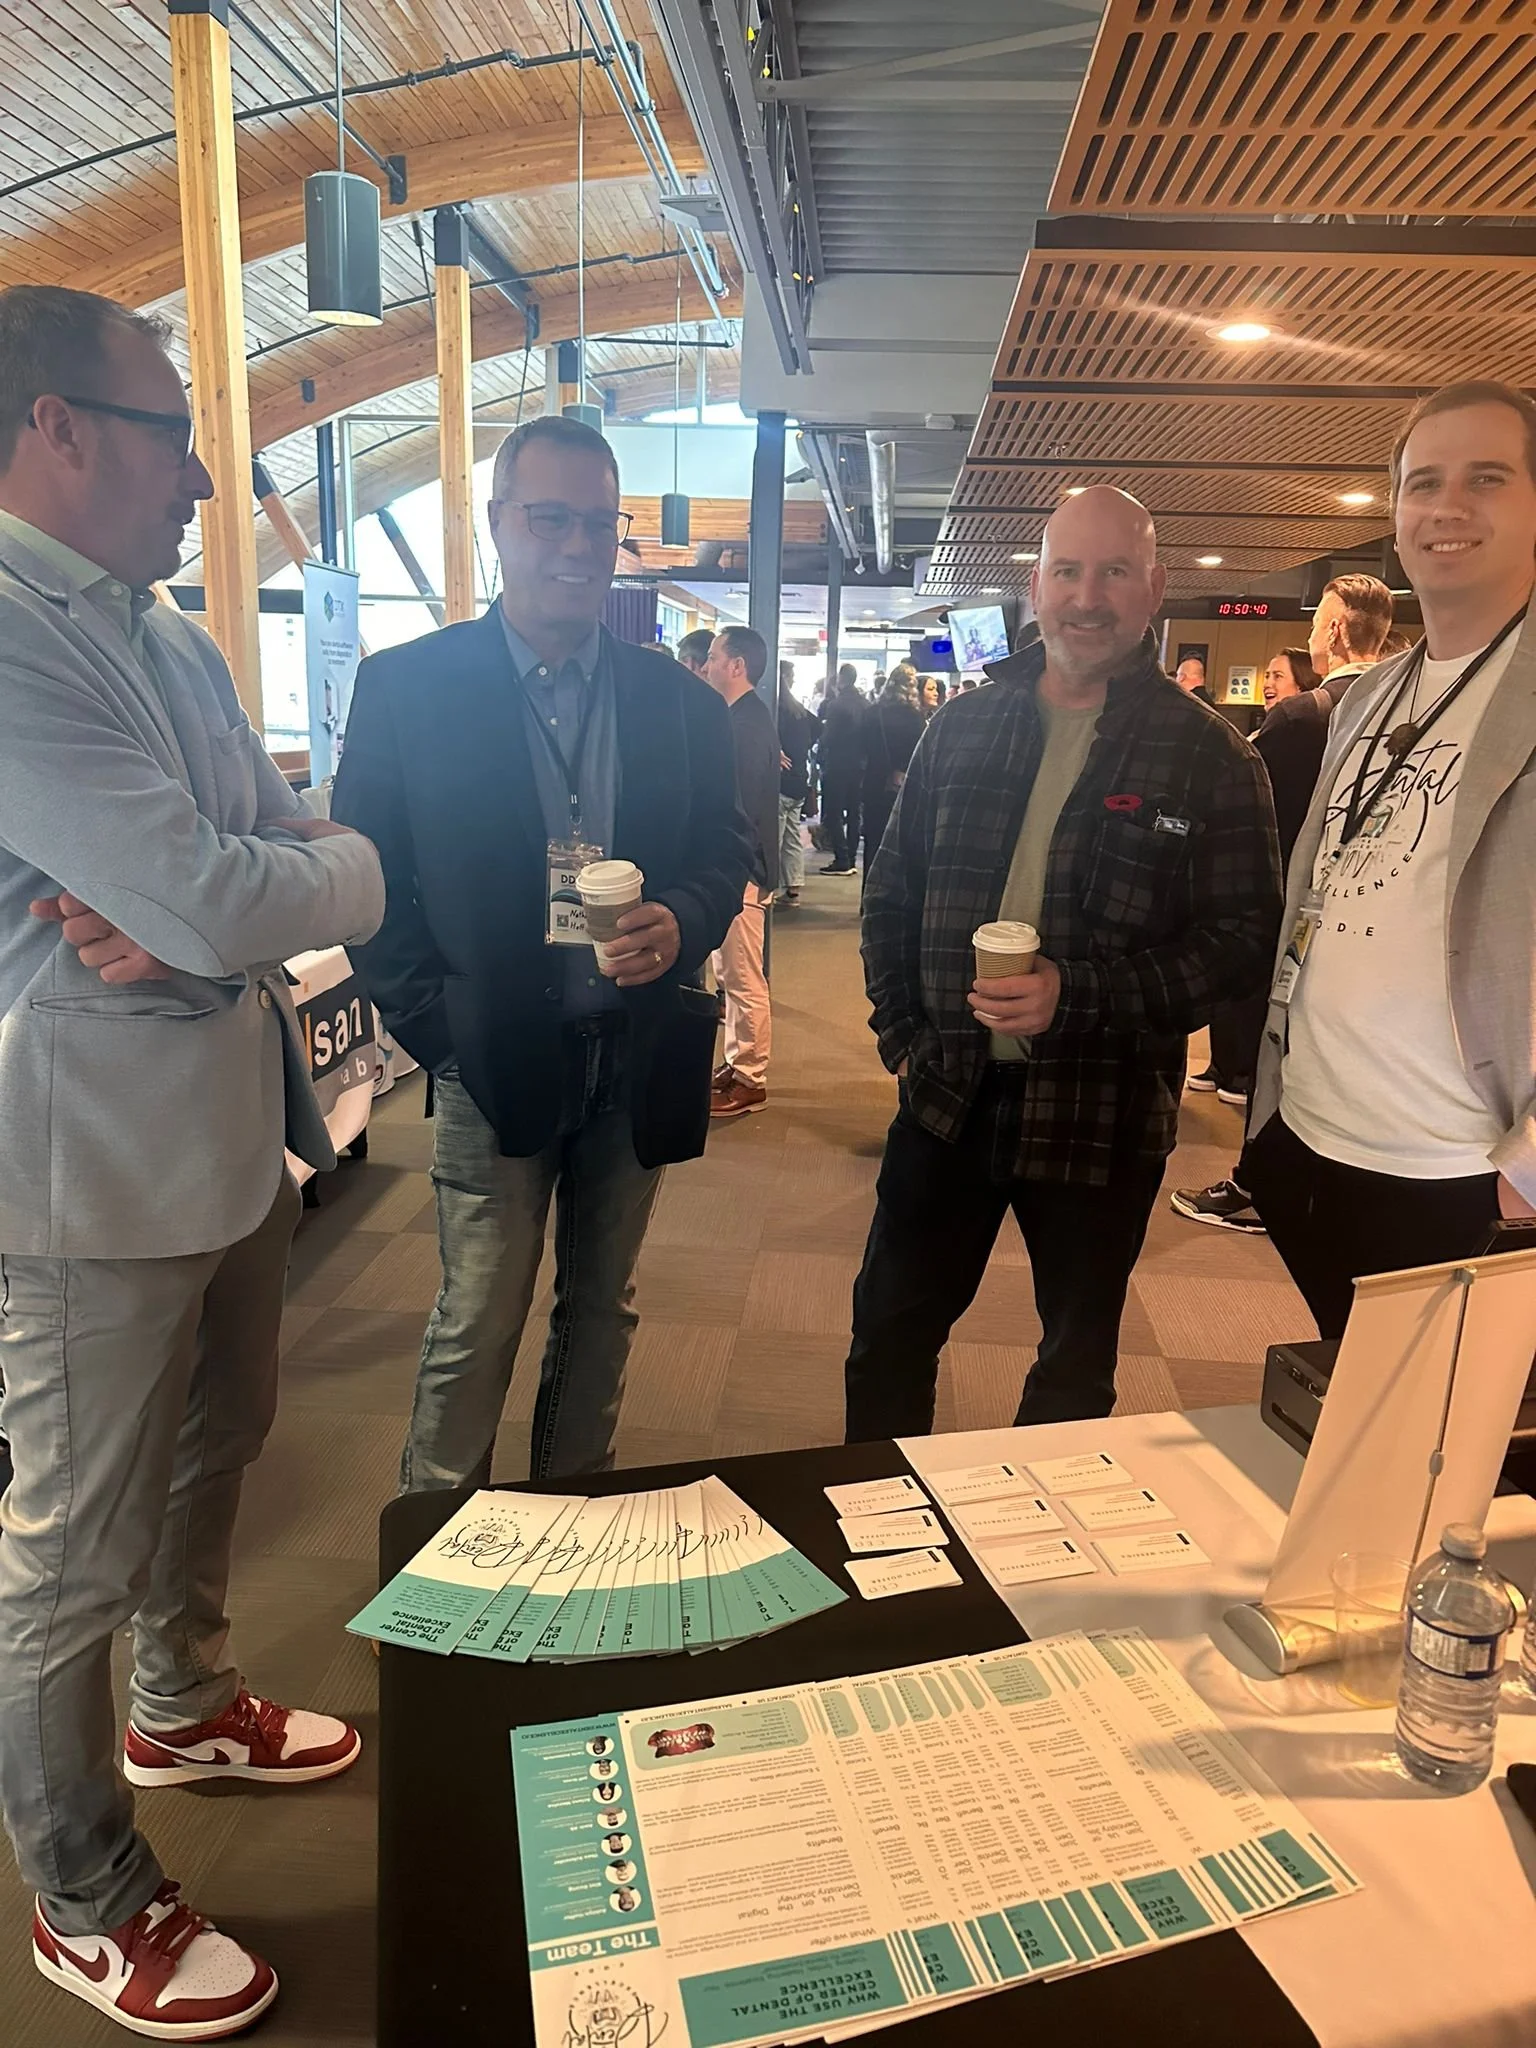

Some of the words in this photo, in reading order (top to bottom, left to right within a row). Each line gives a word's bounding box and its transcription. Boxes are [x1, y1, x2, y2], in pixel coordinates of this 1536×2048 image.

[1218, 603, 1268, 615] 10:50:40
[561, 874, 577, 884] DD
[391, 1610, 451, 1627] Excellence
[379, 1623, 418, 1638] Center
[396, 1619, 432, 1633] Dental
[432, 1627, 446, 1636] of
[418, 1630, 439, 1643] The
[807, 1836, 844, 1848] Benefits
[818, 1882, 860, 1897] Dentistry
[842, 1890, 863, 1900] Join
[822, 1895, 836, 1904] Us
[738, 1907, 770, 1920] Digital
[777, 1903, 795, 1914] the
[1147, 1904, 1181, 1919] CENT
[1157, 1914, 1188, 1929] WHY
[611, 1931, 652, 1948] The
[810, 1935, 832, 1947] offer
[832, 1933, 848, 1942] we
[850, 1927, 877, 1941] What
[547, 1939, 606, 1962] Team
[779, 1969, 873, 1995] EXCELLENCE
[819, 1980, 877, 2002] CENTER
[794, 1992, 814, 2006] OF
[846, 1991, 880, 2006] WHY
[731, 1998, 790, 2018] DENTAL
[778, 2005, 809, 2020] THE
[813, 1999, 842, 2013] USE
